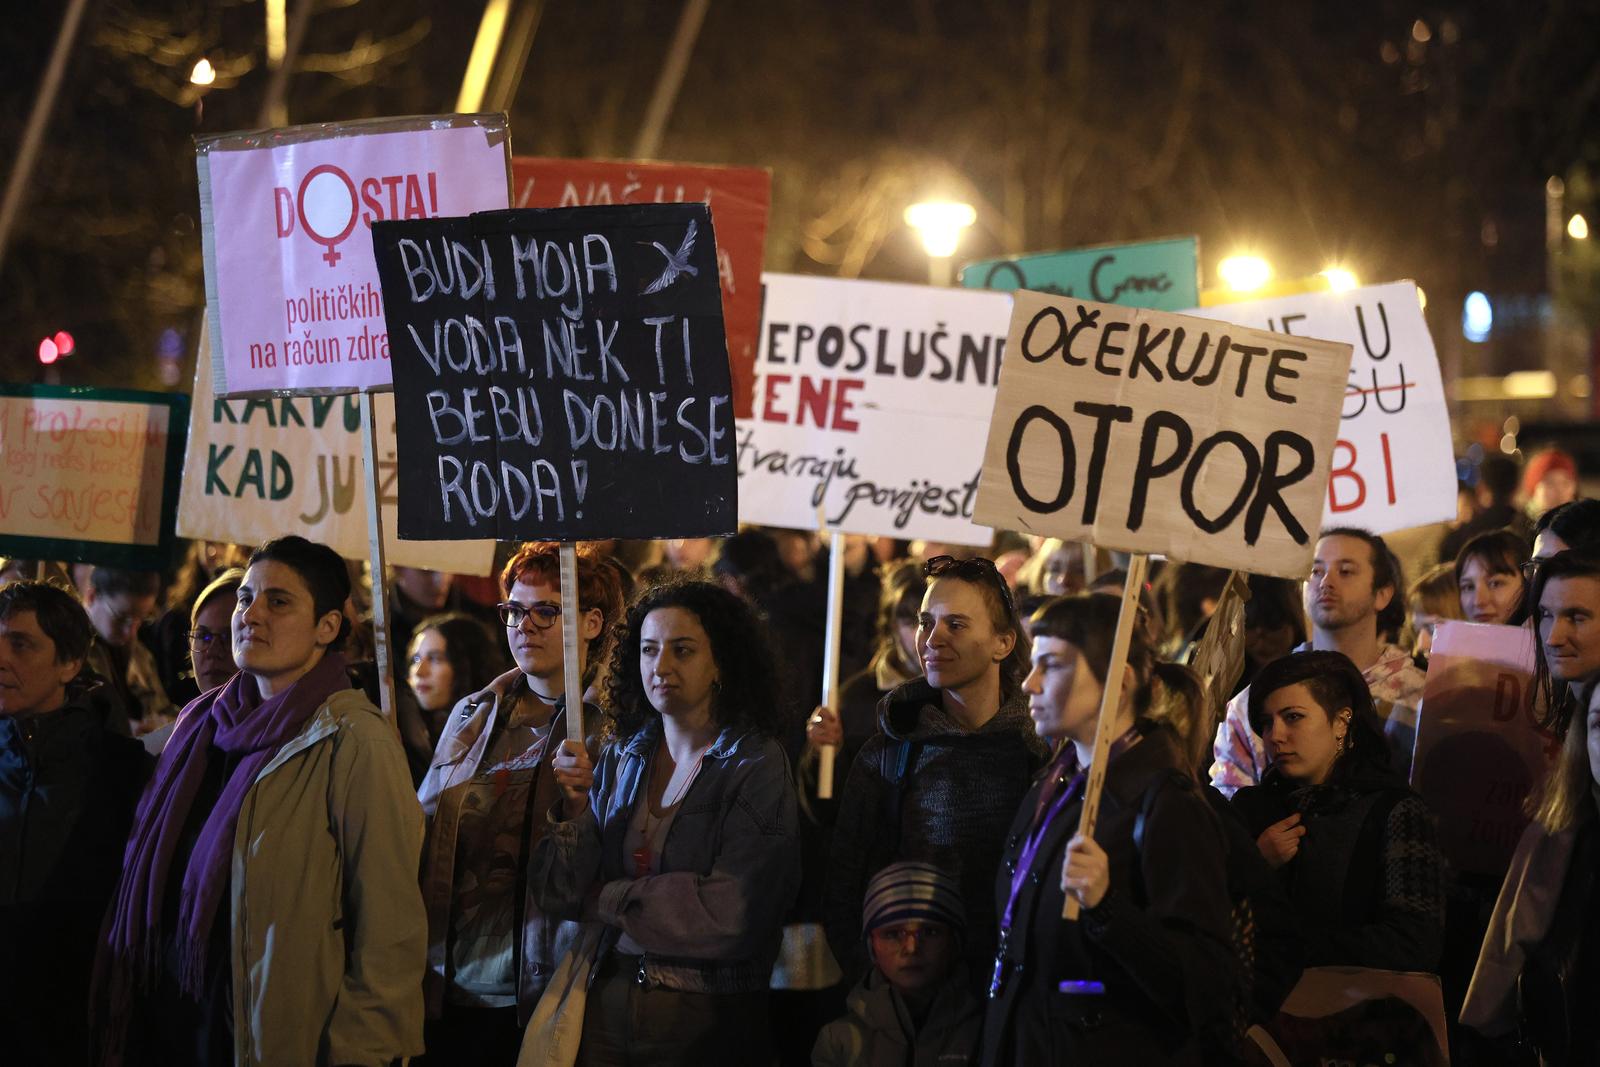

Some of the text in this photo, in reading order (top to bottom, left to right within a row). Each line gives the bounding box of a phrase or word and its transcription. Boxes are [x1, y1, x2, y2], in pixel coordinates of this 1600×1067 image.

[274, 164, 438, 248] DOSTA!
[287, 282, 380, 333] političkih
[399, 234, 617, 320] BUDI MOJA
[250, 341, 276, 369] na
[284, 330, 340, 366] račun
[407, 314, 694, 385] VODA, NEK TI
[759, 320, 1007, 388] EPOSLUŠN
[1021, 305, 1308, 403] OČEKUJTE
[1356, 302, 1390, 361] U
[426, 386, 729, 464] BEBU DONESE
[759, 374, 865, 433] ENE
[205, 443, 294, 501] KAD
[299, 455, 356, 525] JU
[439, 455, 589, 526] RODA!
[737, 430, 859, 507] tvaraju
[1006, 401, 1315, 546] OTPOR
